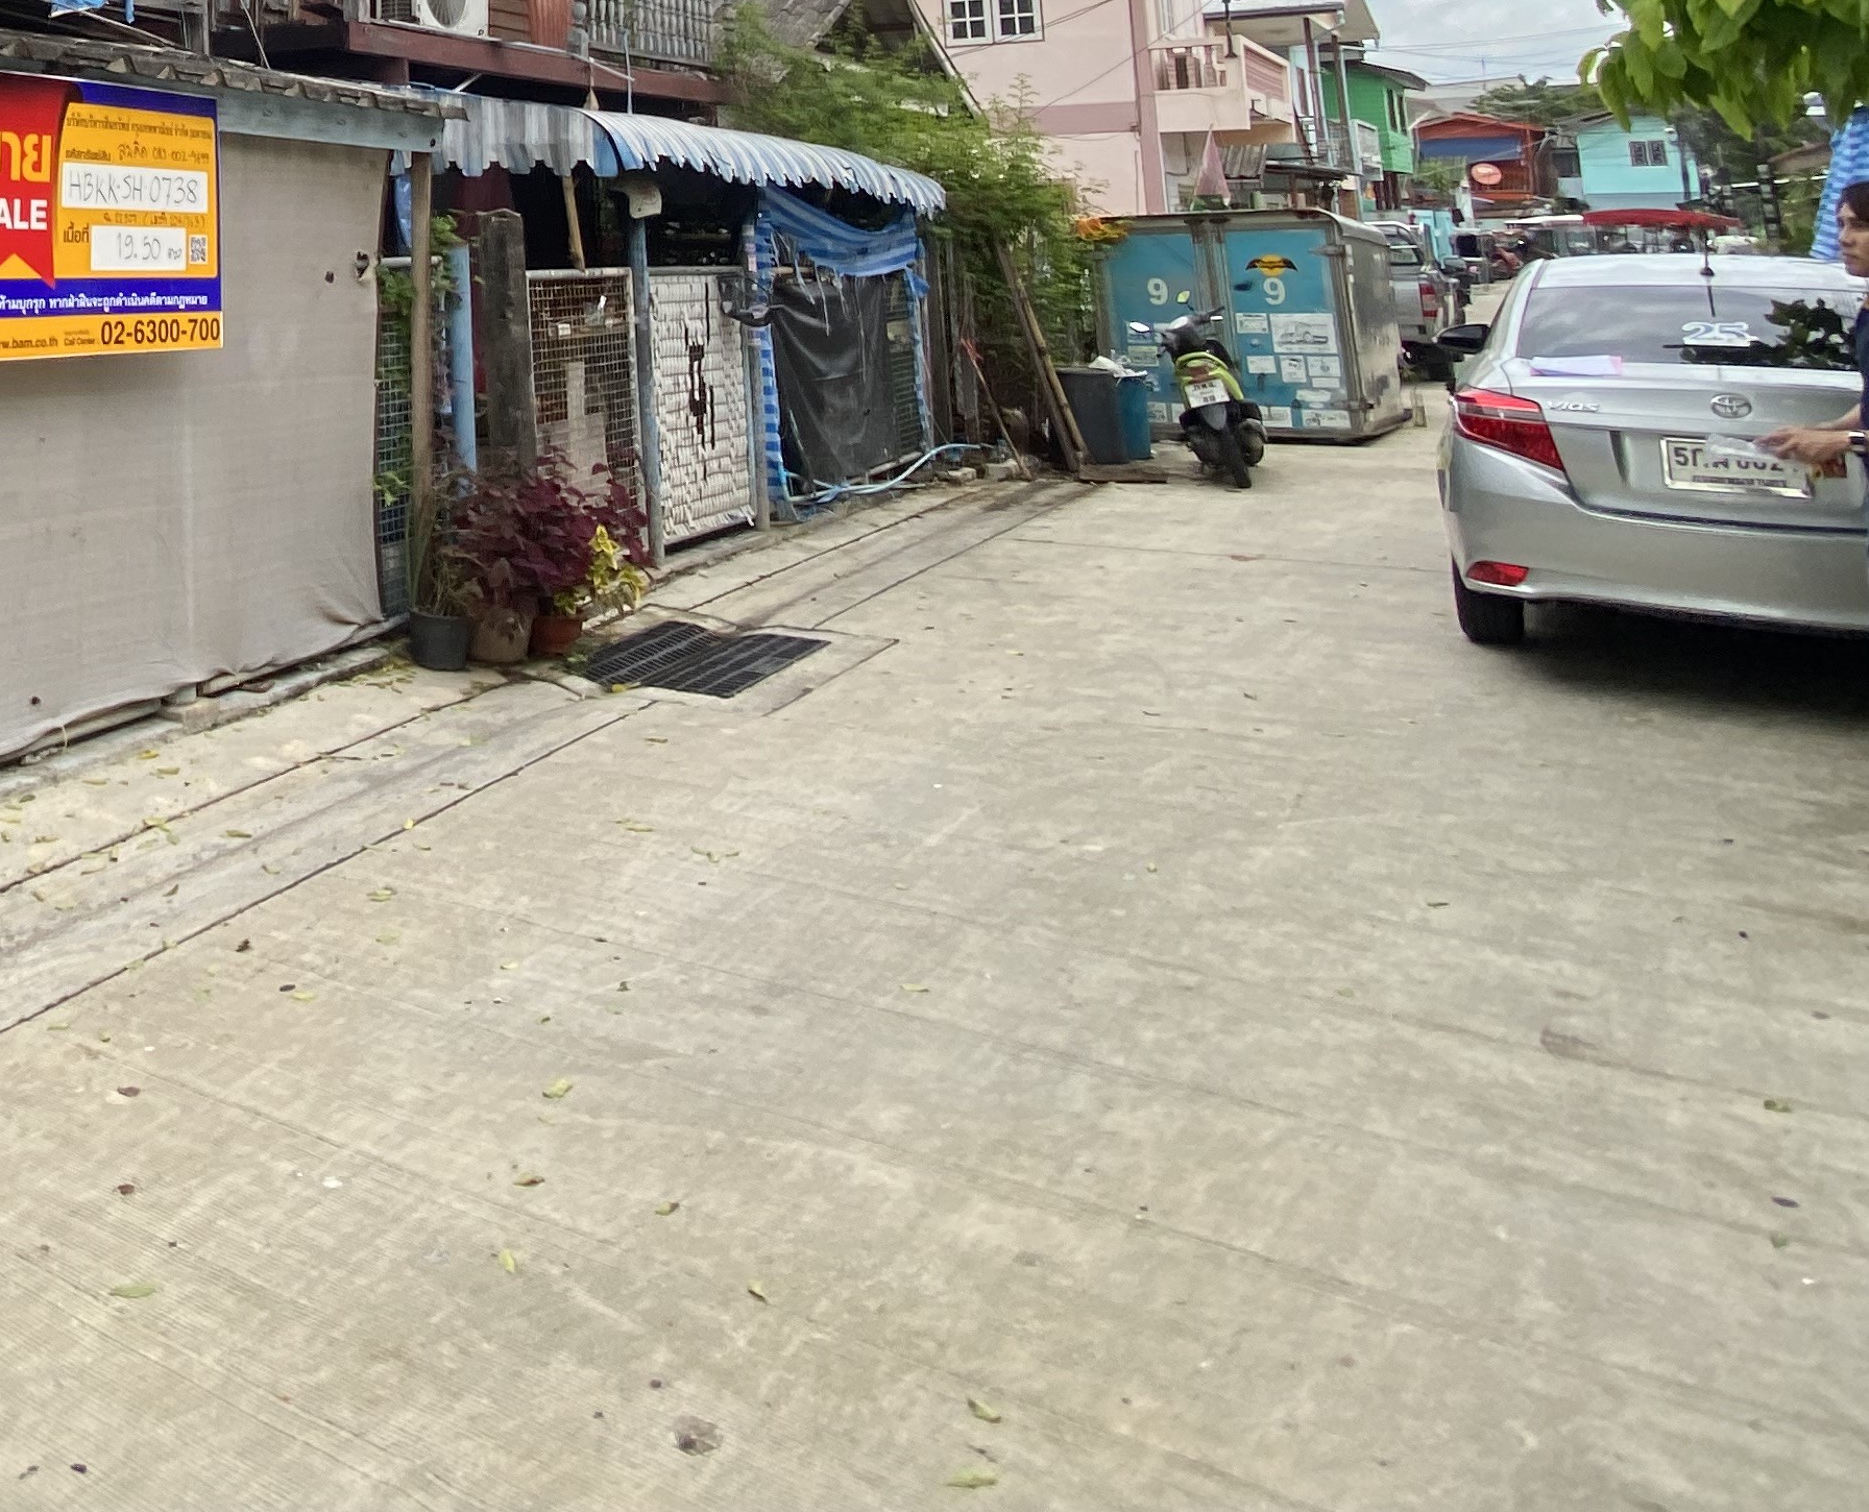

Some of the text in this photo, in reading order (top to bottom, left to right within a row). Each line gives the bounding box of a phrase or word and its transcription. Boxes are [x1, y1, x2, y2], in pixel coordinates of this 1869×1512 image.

[63, 221, 90, 243] เนื้อที่
[117, 232, 161, 260] 19.50
[1147, 277, 1168, 305] 9
[1263, 277, 1286, 305] 9
[101, 318, 220, 345] 02-6300-700
[1682, 321, 1750, 346] 25
